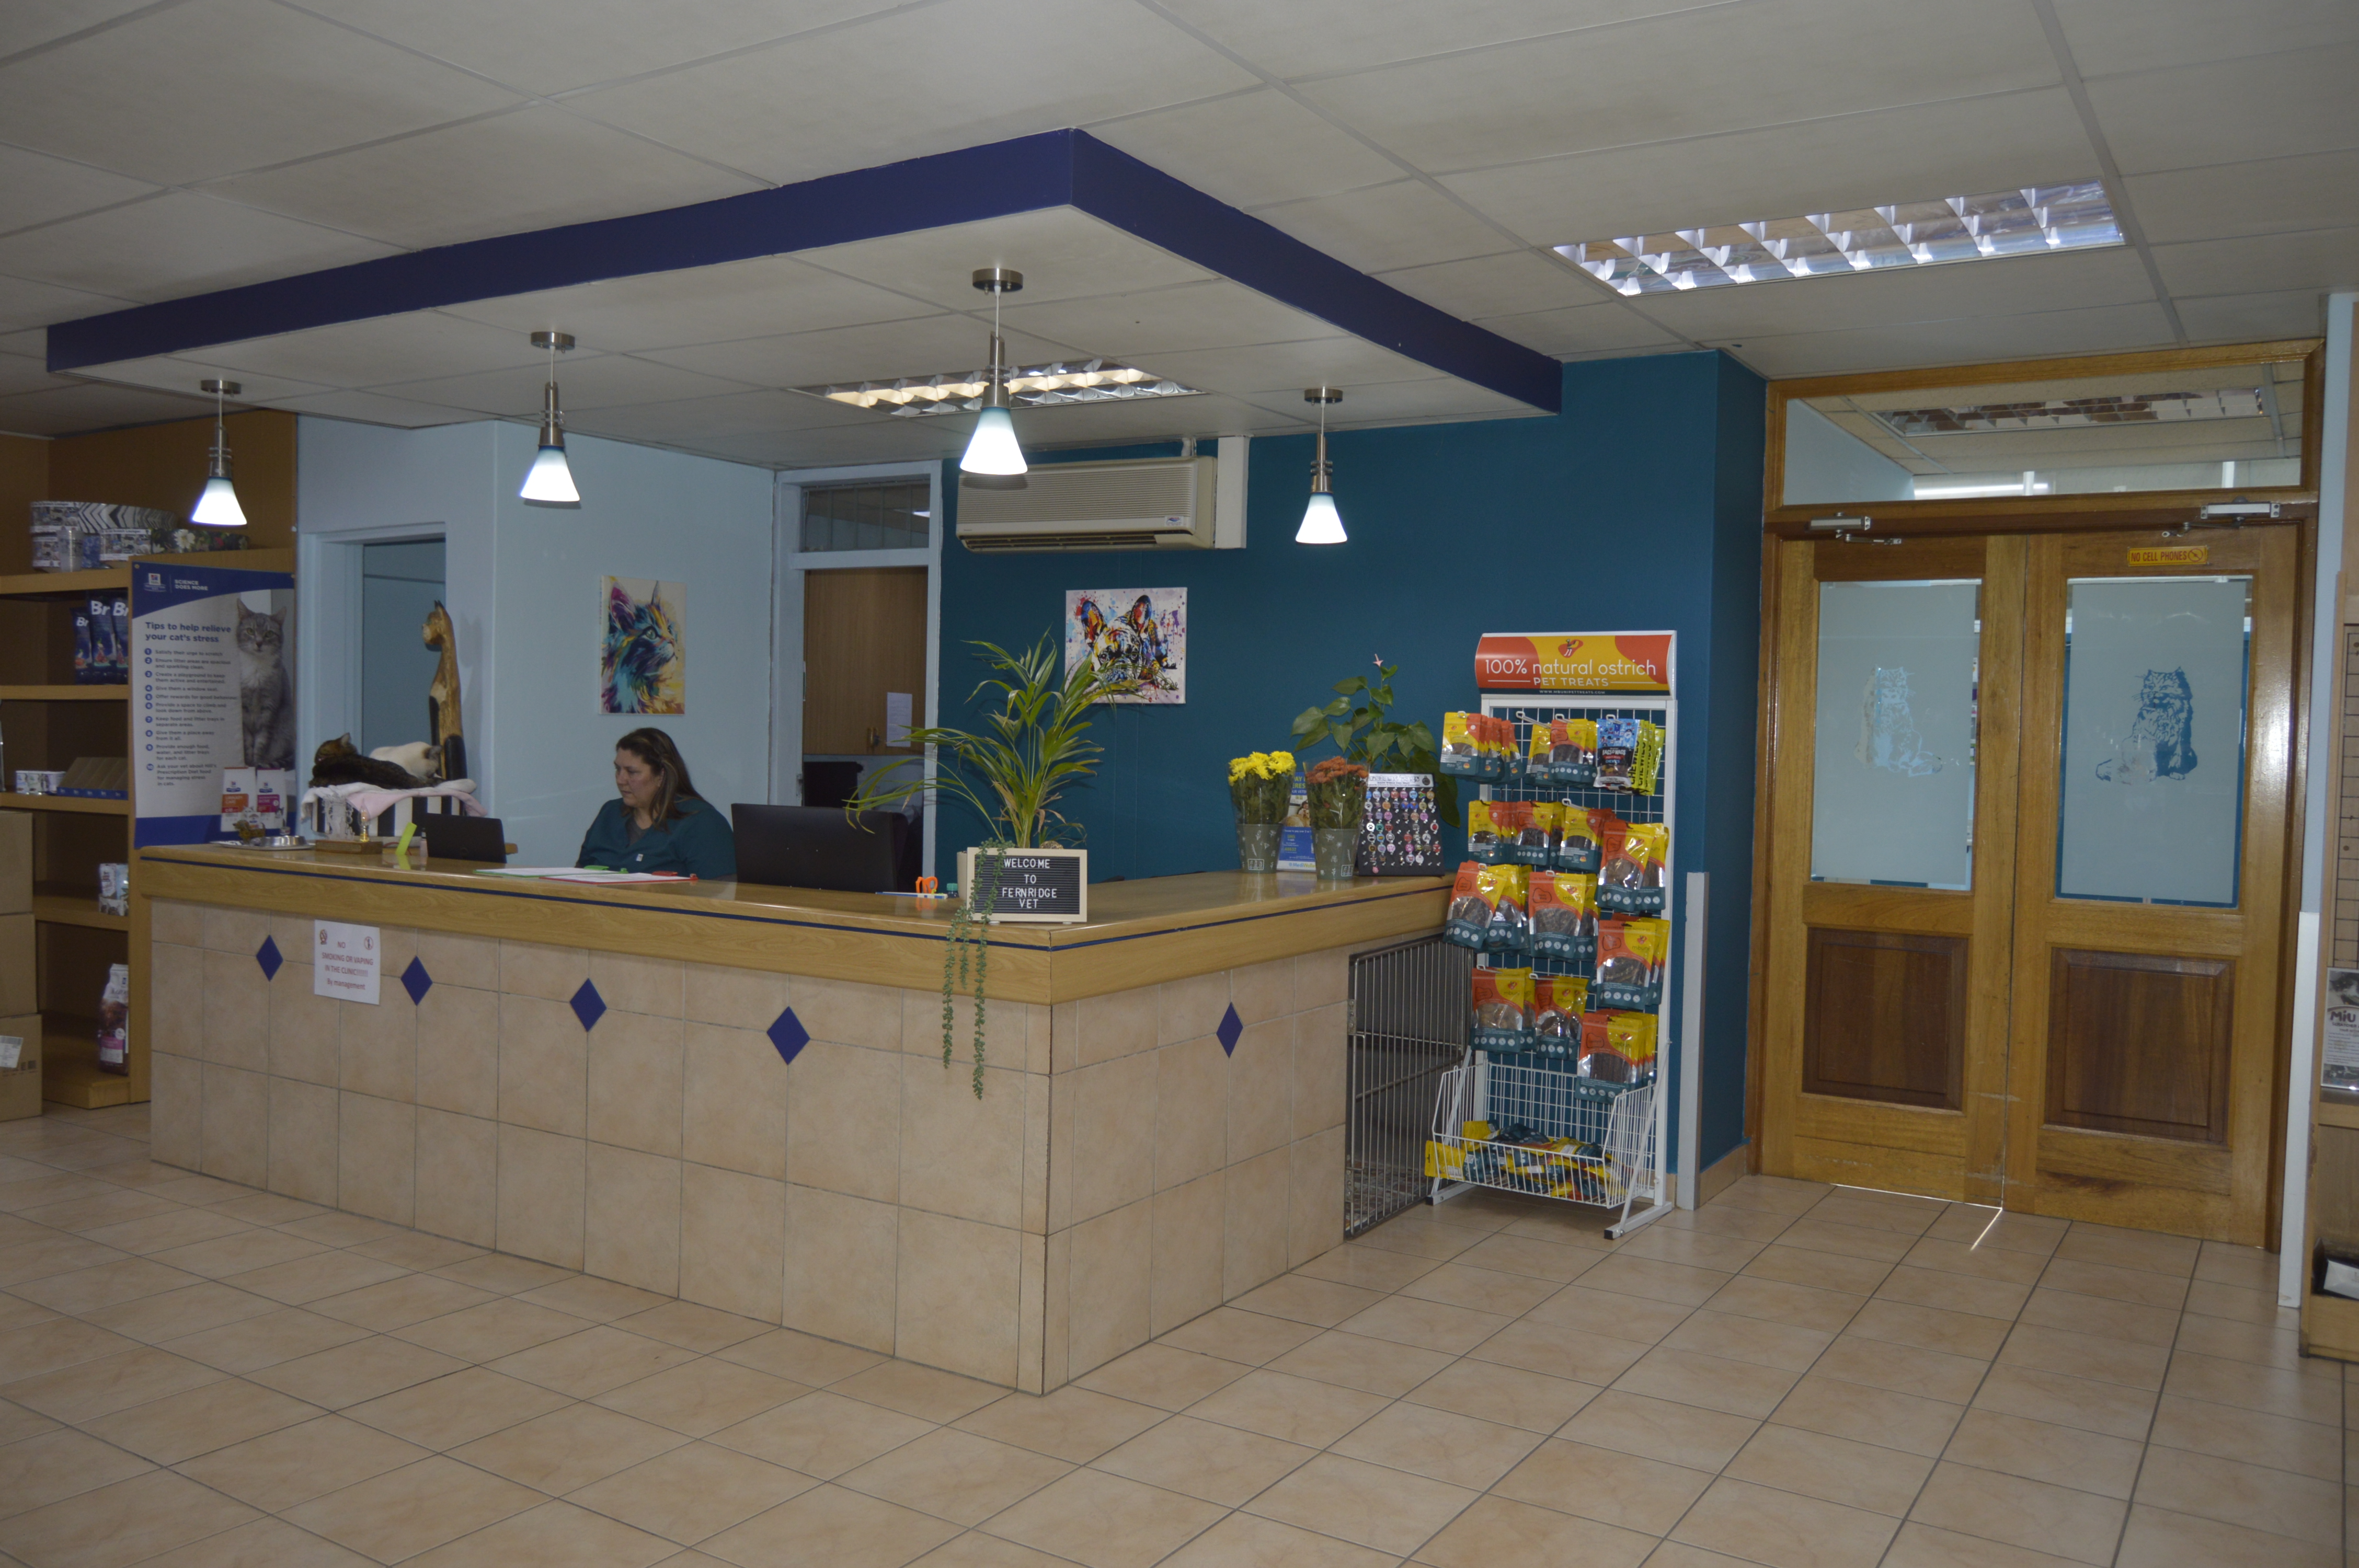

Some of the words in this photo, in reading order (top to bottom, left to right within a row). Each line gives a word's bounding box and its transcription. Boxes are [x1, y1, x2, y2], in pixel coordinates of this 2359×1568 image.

[2131, 552, 2140, 562] NO
[2143, 552, 2158, 561] CELL
[2161, 551, 2187, 560] PHONES
[145, 622, 165, 631] Tips
[180, 623, 199, 632] help
[169, 633, 191, 642] cat's
[1485, 659, 1527, 675] 100%
[1532, 659, 1593, 675] natural
[1598, 659, 1656, 676] ostrich
[1533, 677, 1556, 686] PET
[1560, 677, 1609, 687] TREATS
[1004, 858, 1050, 869] WELCOME
[1024, 874, 1036, 884] TO
[1002, 887, 1057, 898] FERNRIDGE
[1019, 899, 1039, 908] VET
[322, 952, 345, 962] SMOKING
[354, 957, 373, 965] VAPING
[334, 981, 365, 989] management
